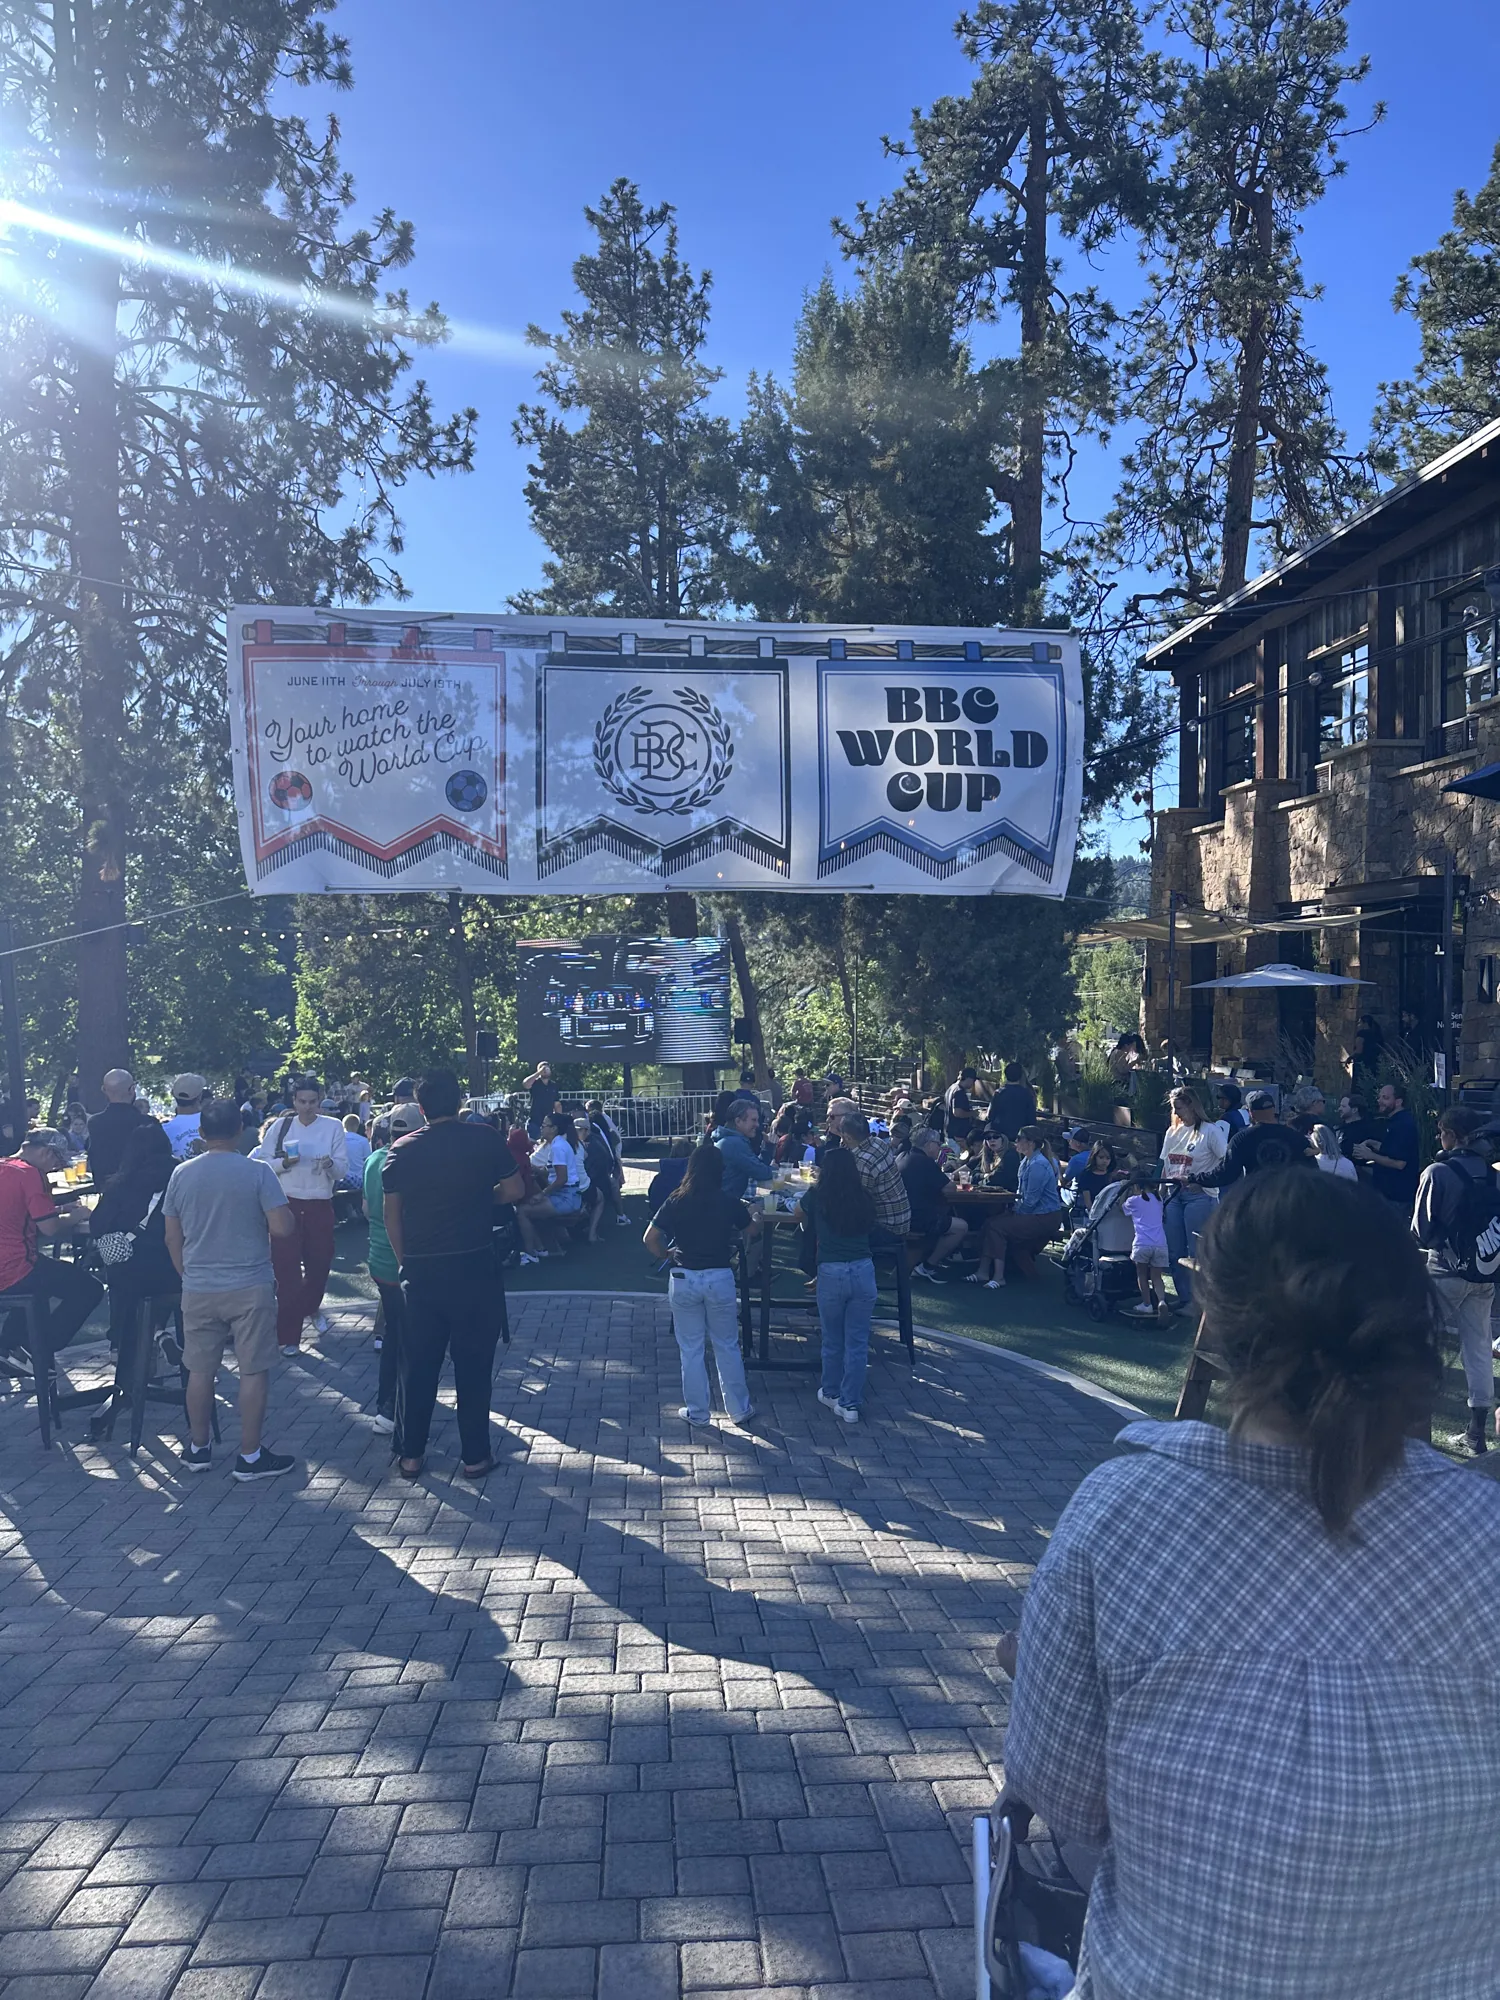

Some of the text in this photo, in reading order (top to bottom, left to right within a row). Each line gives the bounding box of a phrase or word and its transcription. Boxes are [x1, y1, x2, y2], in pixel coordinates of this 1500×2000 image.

[287, 675, 462, 691] JUNE 11TH Through JULY 19TH
[884, 686, 999, 725] BBC
[265, 699, 410, 762] Your home
[306, 709, 457, 766] to watch the
[836, 728, 1049, 769] WORLD
[338, 729, 488, 788] World Cup
[887, 771, 1002, 813] CUP
